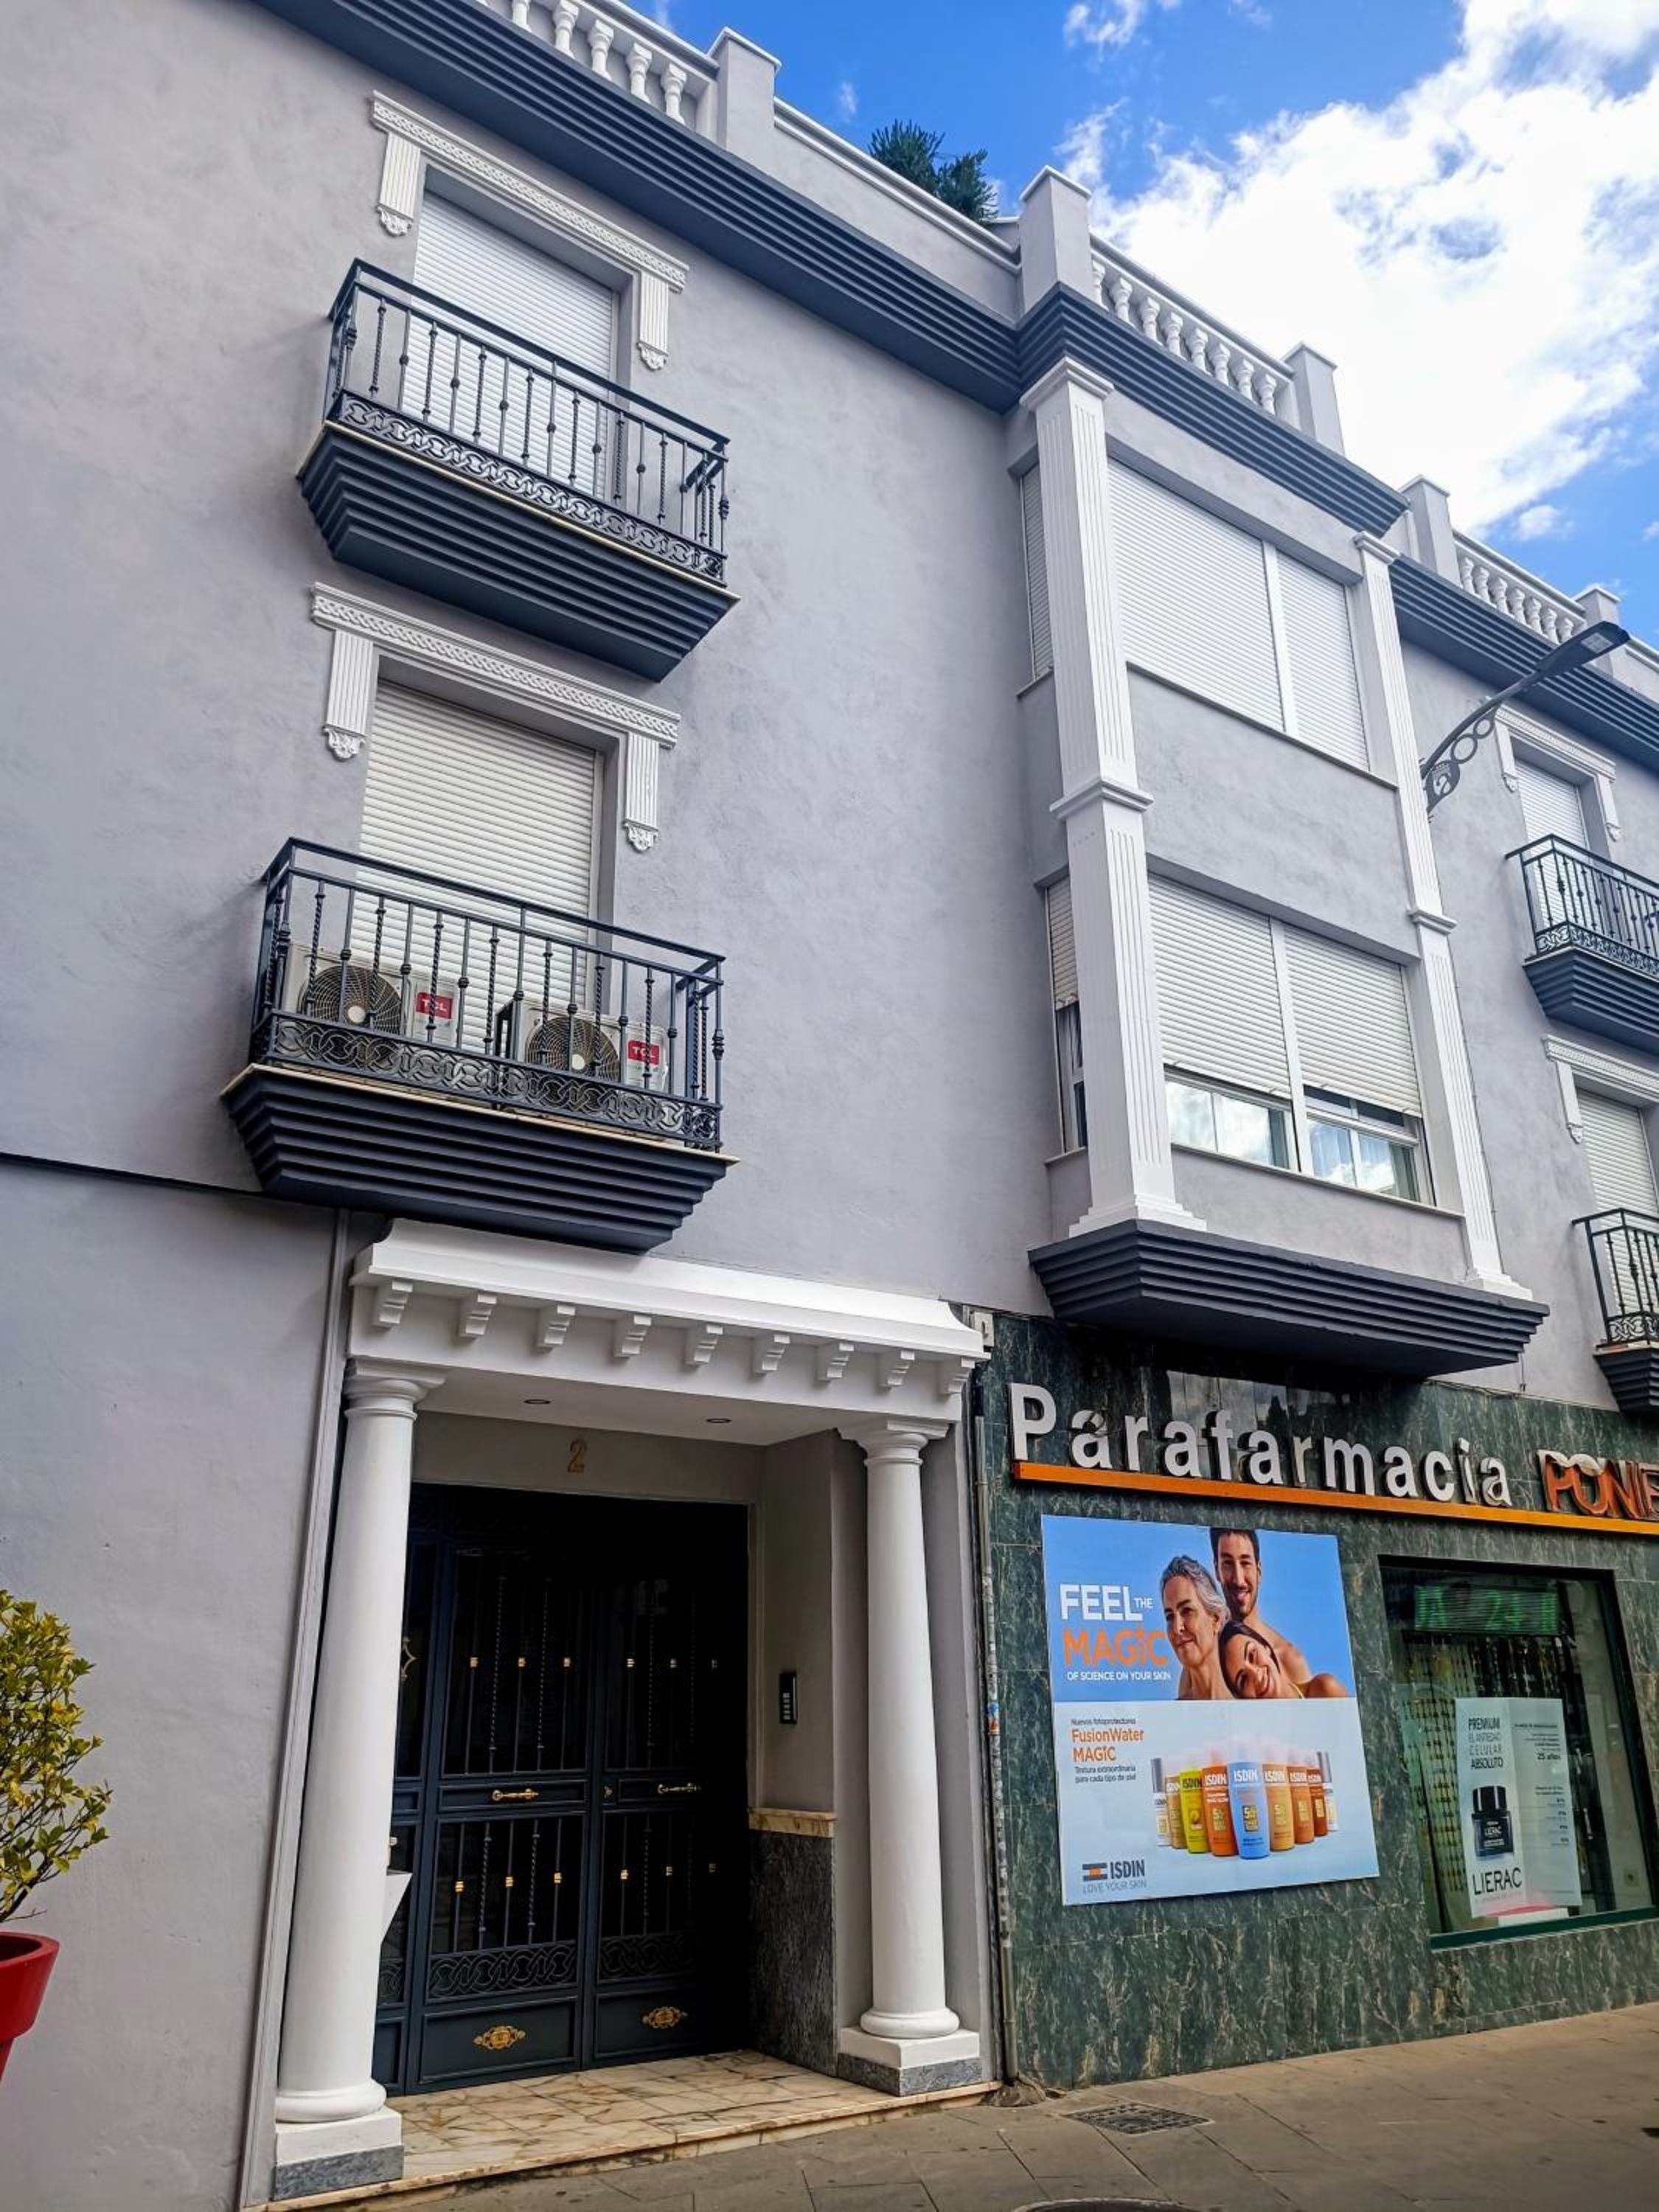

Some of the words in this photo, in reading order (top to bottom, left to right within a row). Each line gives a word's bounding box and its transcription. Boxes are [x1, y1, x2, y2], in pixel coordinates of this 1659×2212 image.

[1010, 1382, 1512, 1508] Parafarmacia
[567, 1439, 588, 1474] 2
[1060, 1584, 1143, 1621] FEEL
[1134, 1597, 1154, 1609] THE
[1067, 1672, 1079, 1681] OF
[1080, 1672, 1115, 1681] SCIENCE
[1116, 1672, 1129, 1681] ON
[1130, 1672, 1152, 1681] YOUR
[1152, 1672, 1172, 1681] SKIN
[1468, 1717, 1500, 1731] PREMIUM
[1072, 1728, 1144, 1743] FusionWater
[1470, 1757, 1503, 1769] ABSOLUTO
[1110, 1859, 1145, 1879] ISDIN
[1082, 1882, 1105, 1894] LOVE
[1472, 1867, 1523, 1896] LIERAC
